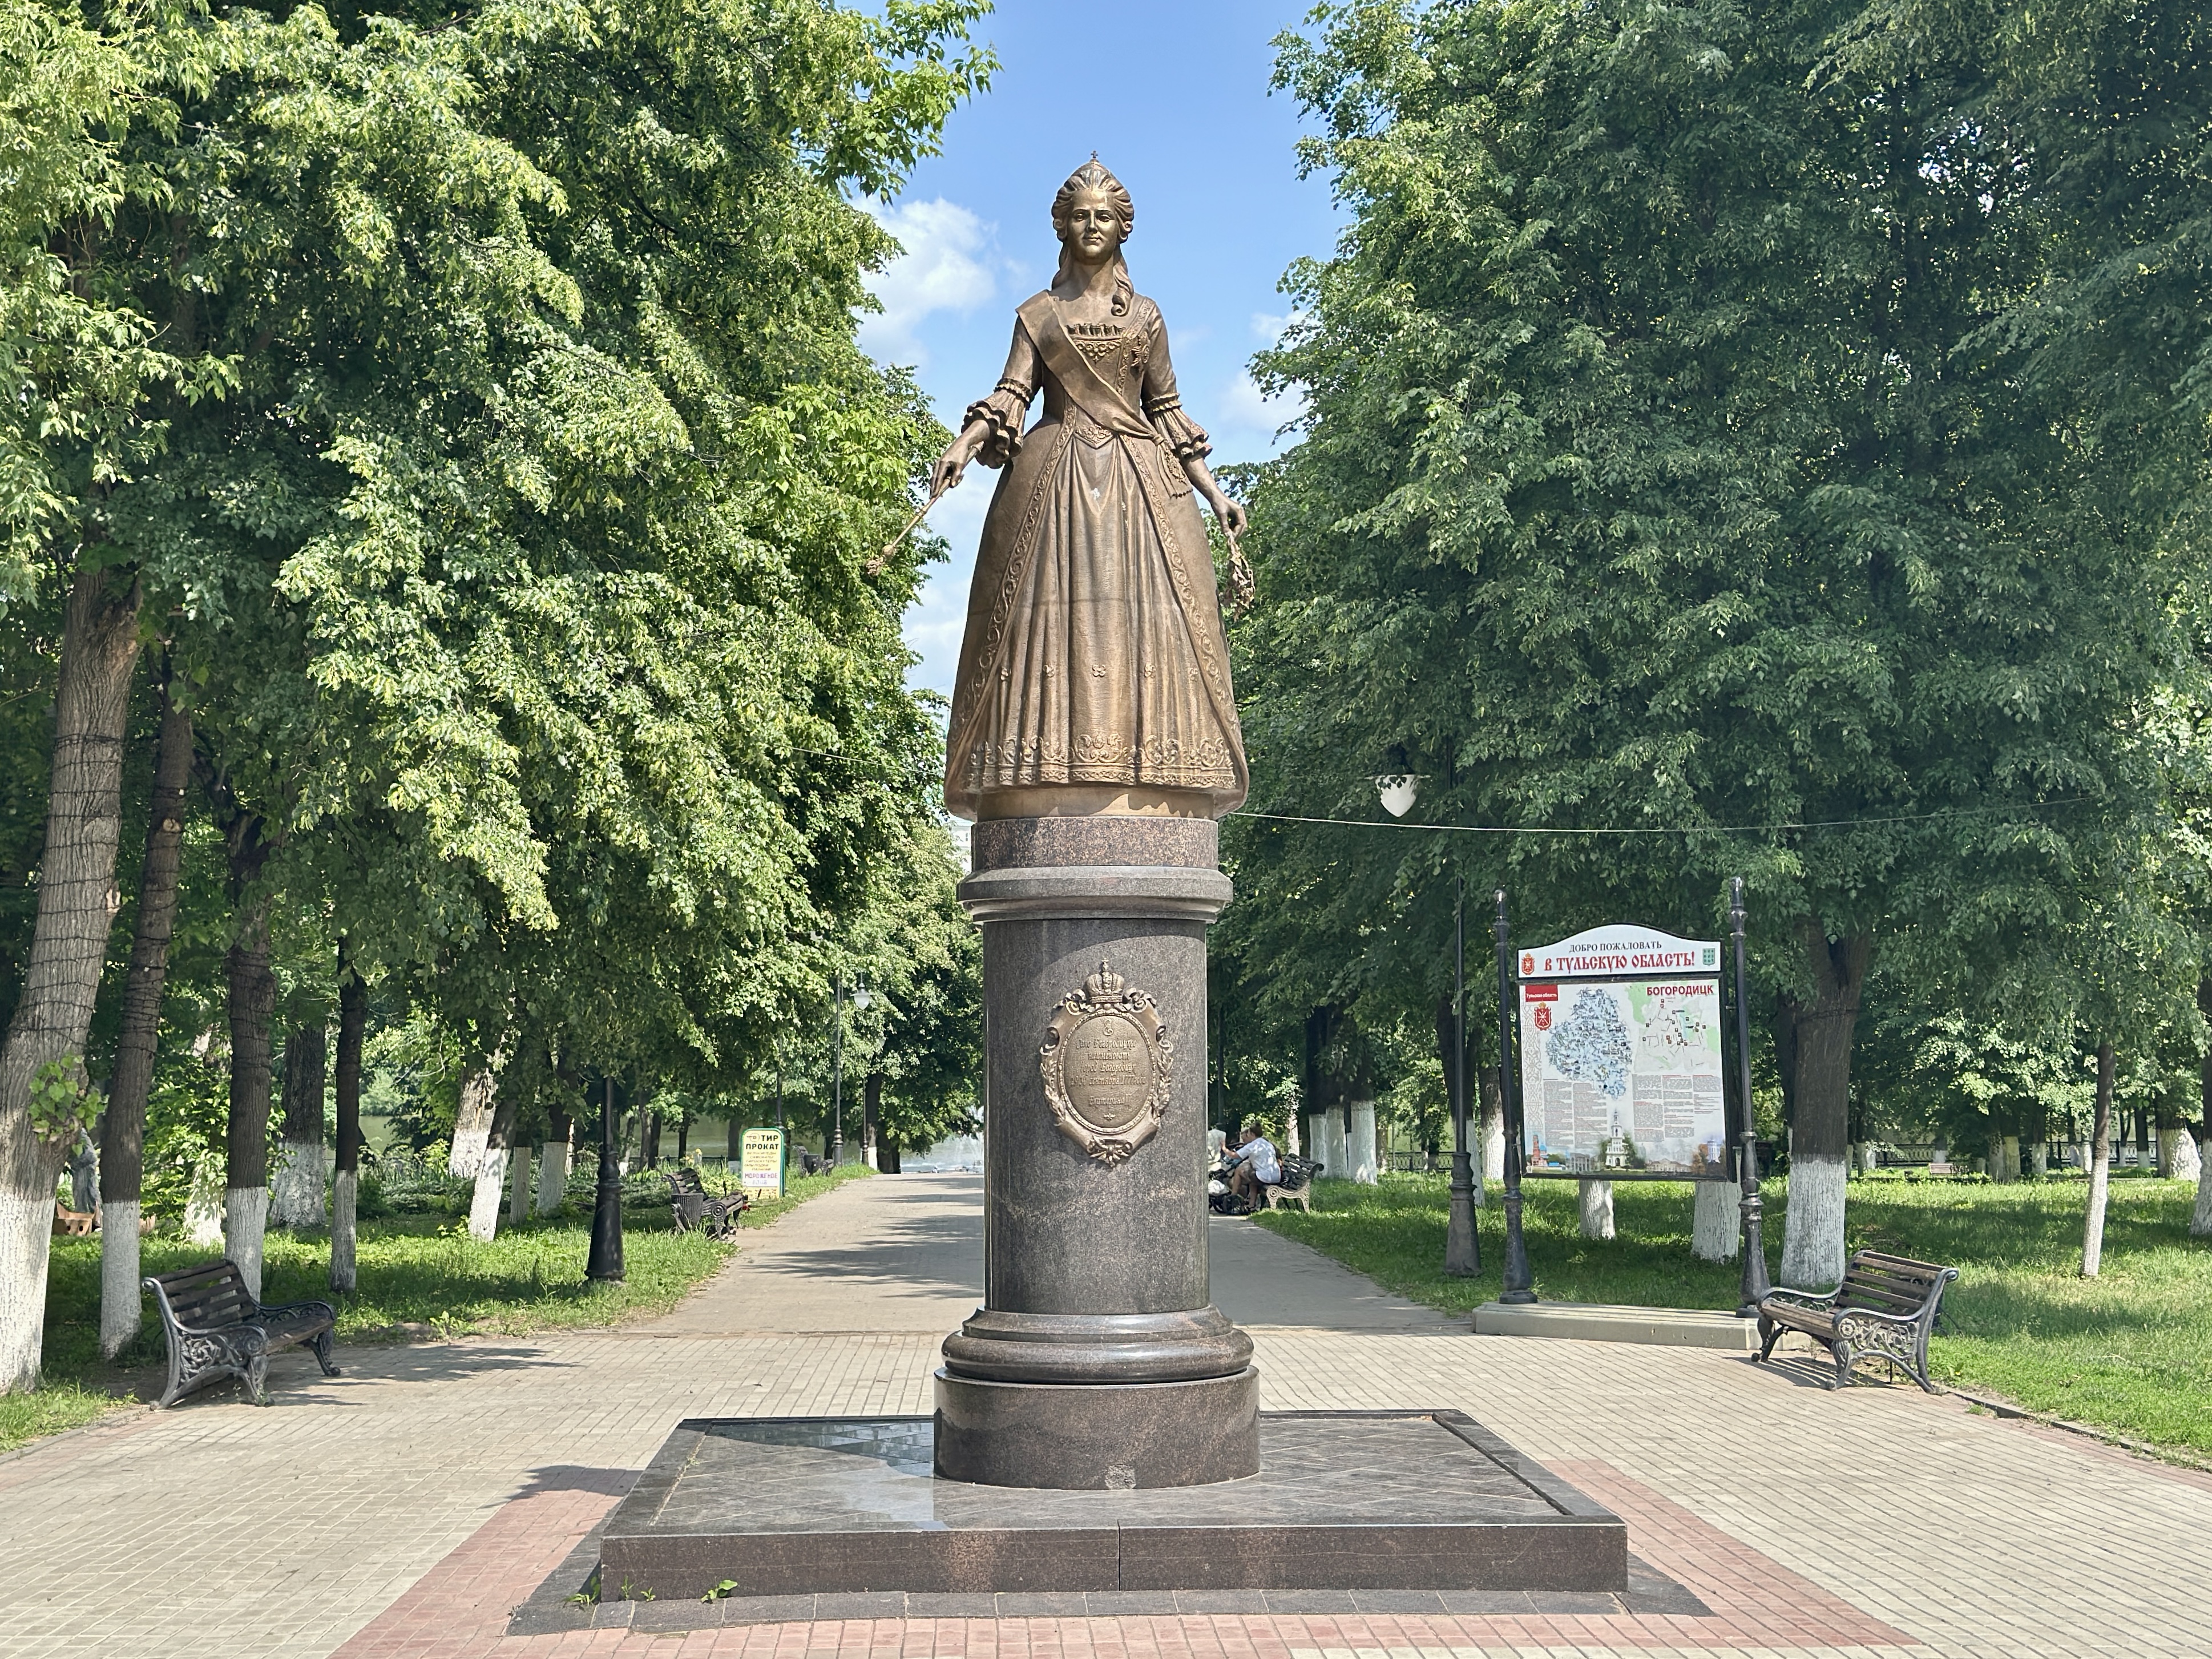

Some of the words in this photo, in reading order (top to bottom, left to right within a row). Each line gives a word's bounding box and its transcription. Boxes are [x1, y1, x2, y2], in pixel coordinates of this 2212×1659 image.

[1569, 943, 1597, 953] ДОБРО
[1600, 940, 1662, 951] ПОЖАЛОВАТЬ
[1556, 954, 1627, 974] ТУЛЬСКУЮ
[1632, 951, 1695, 968] ОБЛАСТЬ!
[1646, 985, 1713, 997] БОГОРОДИЦК
